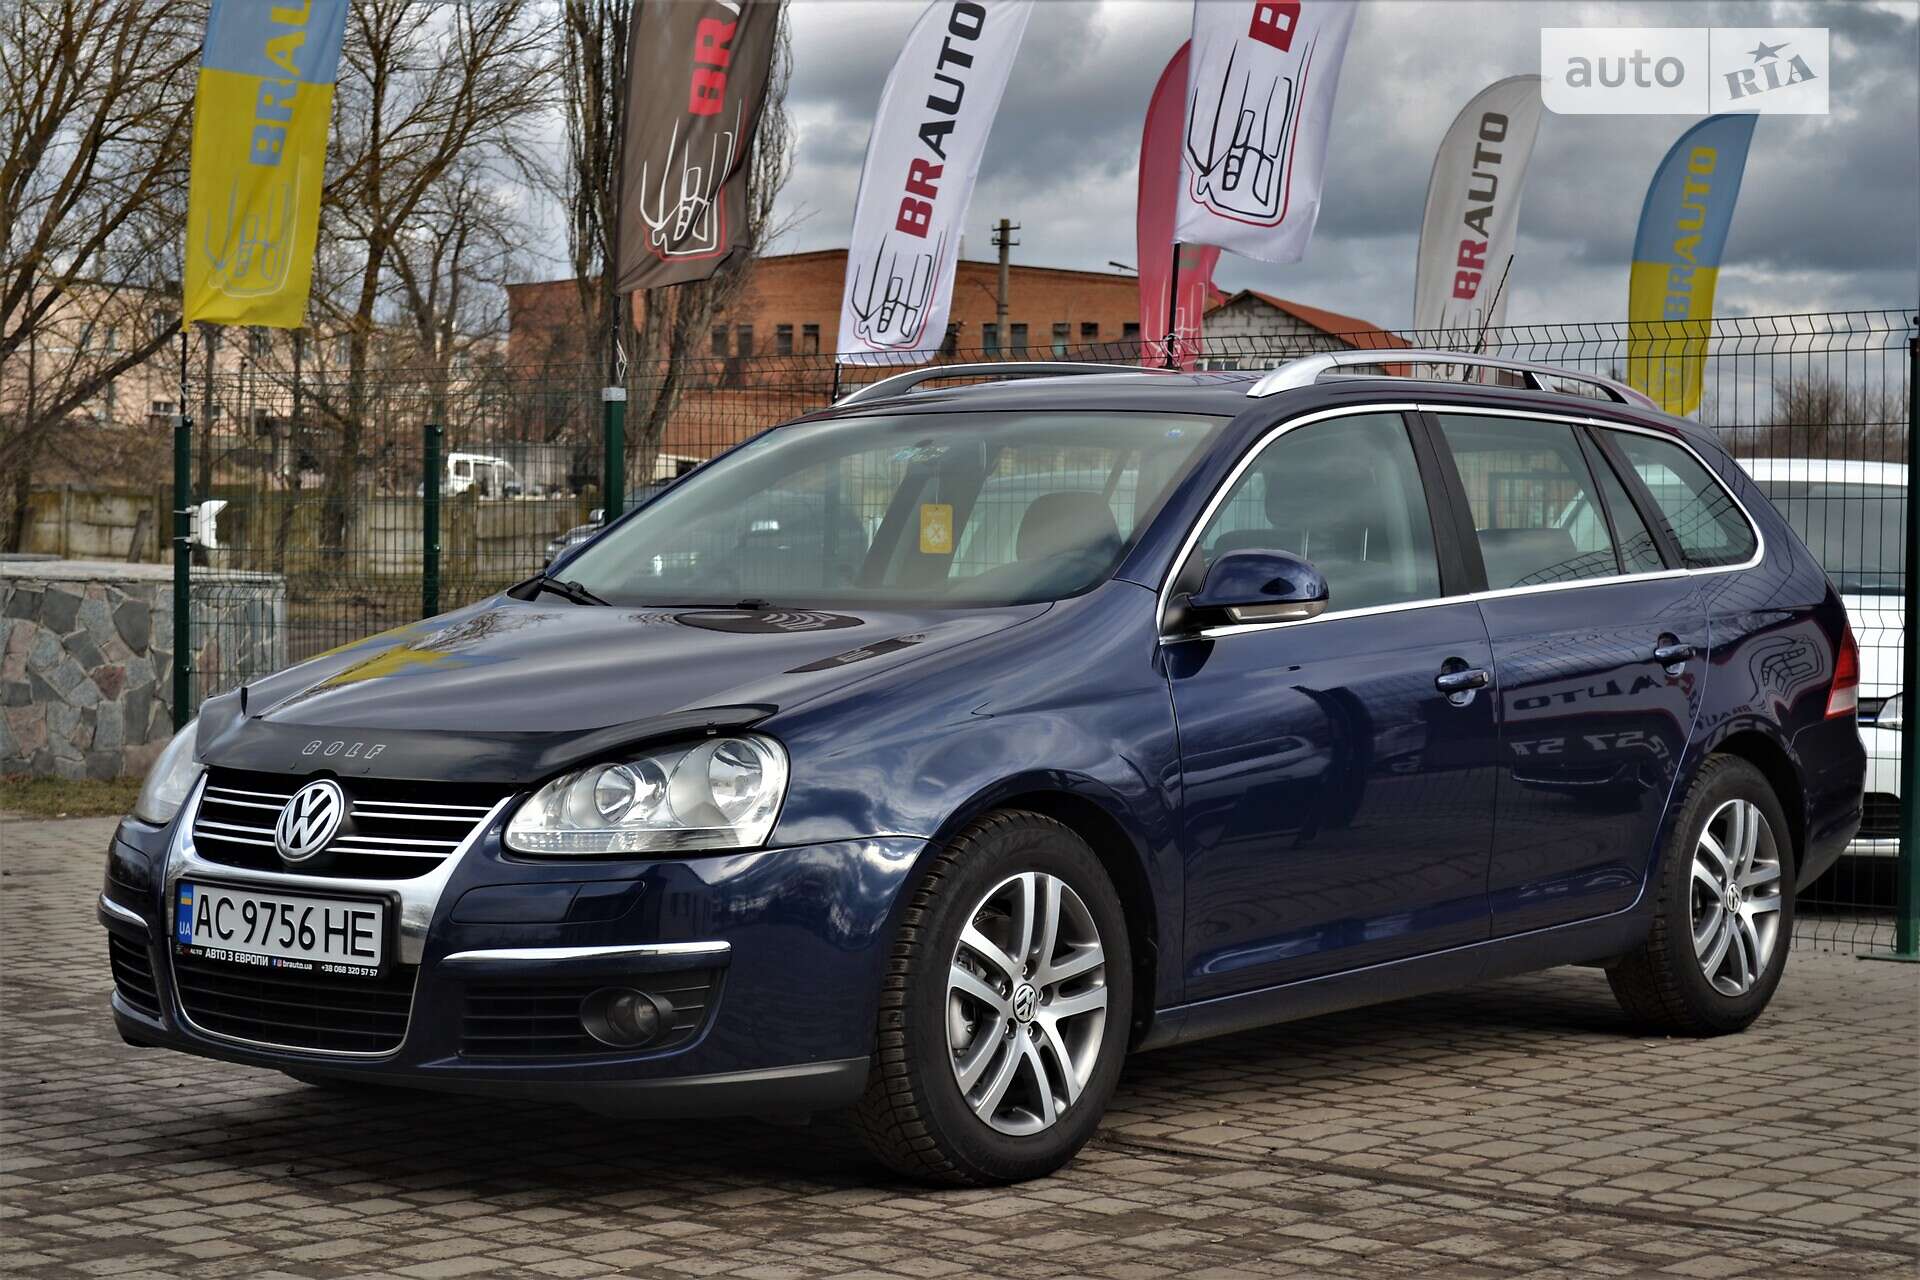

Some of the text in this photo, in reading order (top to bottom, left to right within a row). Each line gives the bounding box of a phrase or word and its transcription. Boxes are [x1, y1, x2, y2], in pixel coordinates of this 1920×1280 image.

[895, 0, 986, 239] BRAUTO
[1453, 112, 1509, 300] BRAUTO
[1663, 146, 1718, 321] BRAUTO
[302, 740, 386, 759] GOLF
[179, 920, 192, 936] UA
[242, 899, 315, 950] 9756
